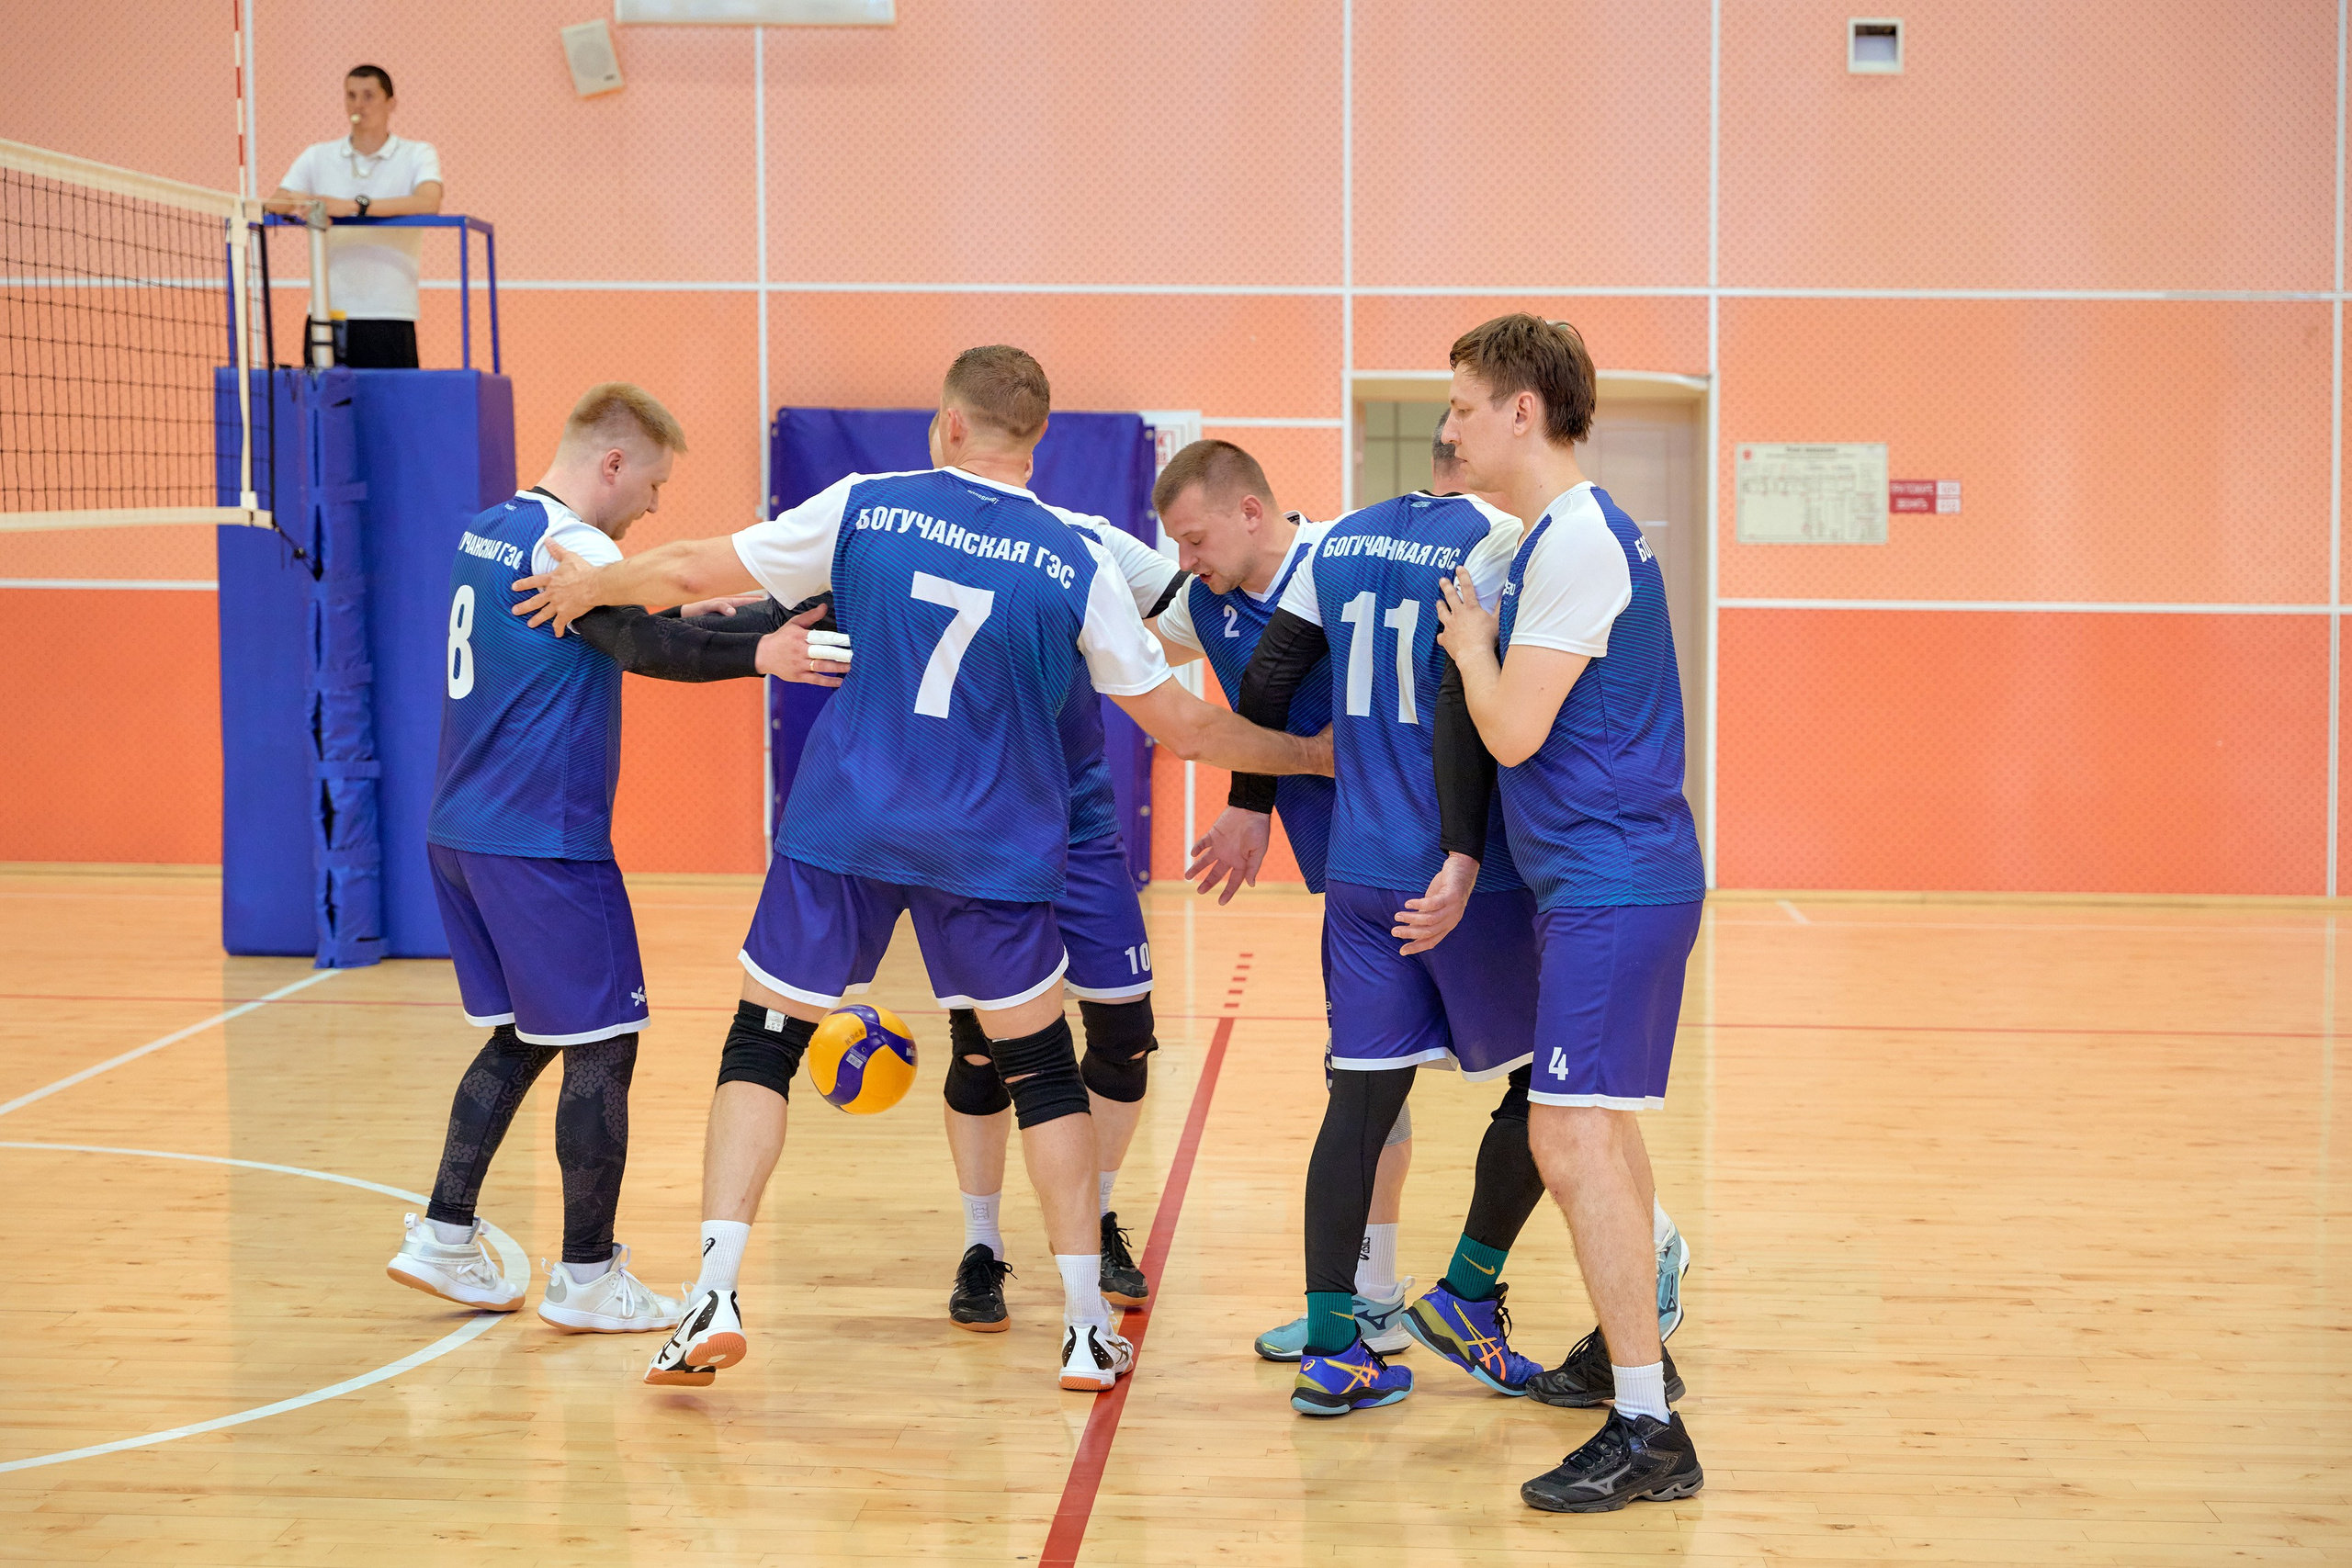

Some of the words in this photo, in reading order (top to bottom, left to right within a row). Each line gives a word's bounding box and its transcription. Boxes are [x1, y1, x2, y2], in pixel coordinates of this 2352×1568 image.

[855, 506, 1030, 564] БОГУЧАНСКАЯ
[1034, 545, 1076, 590] ГЭС
[1430, 546, 1461, 570] ГЭС
[447, 584, 475, 700] 8
[910, 570, 995, 719] 7
[1223, 604, 1240, 638] 2
[1340, 591, 1420, 725] 11
[1125, 942, 1151, 976] 10
[1548, 1046, 1569, 1081] 4
